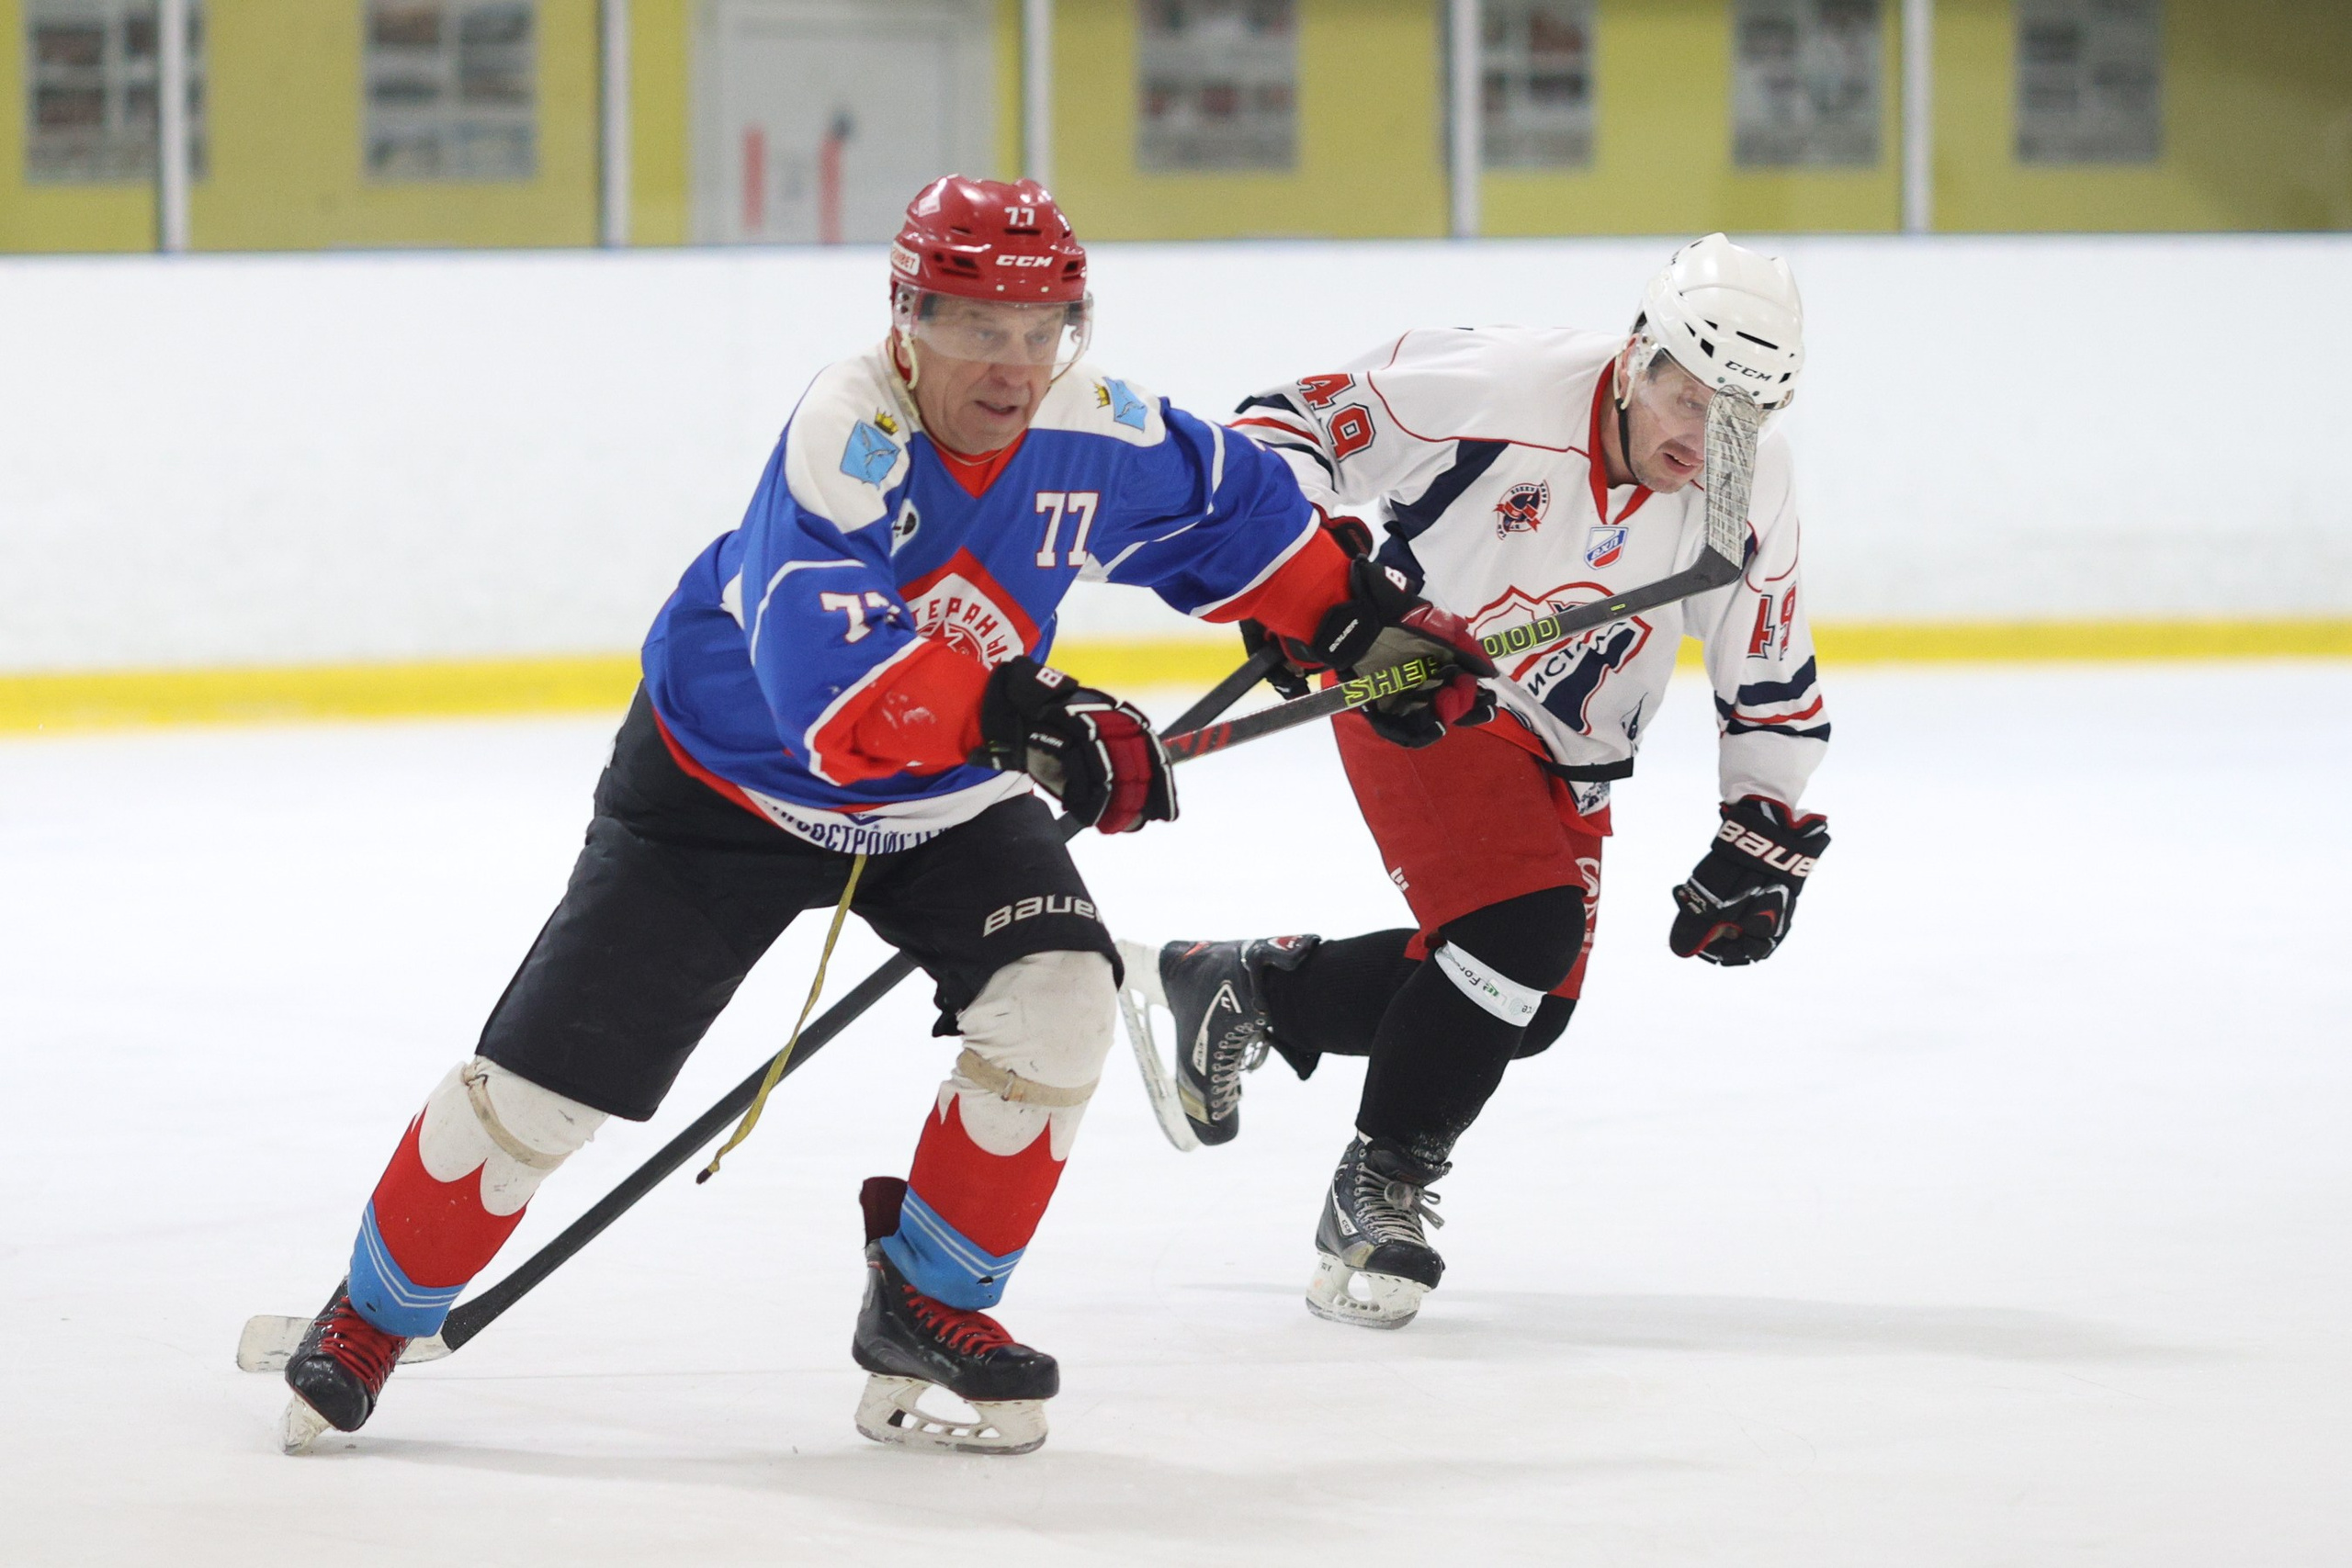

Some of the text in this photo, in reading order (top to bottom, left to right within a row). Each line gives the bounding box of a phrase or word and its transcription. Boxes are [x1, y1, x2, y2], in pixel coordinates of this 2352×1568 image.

[1005, 207, 1035, 227] 77
[996, 255, 1054, 267] CCM
[1724, 360, 1772, 382] CCM
[1296, 372, 1376, 463] 49
[1035, 490, 1101, 569] 77
[1717, 819, 1819, 877] Baue
